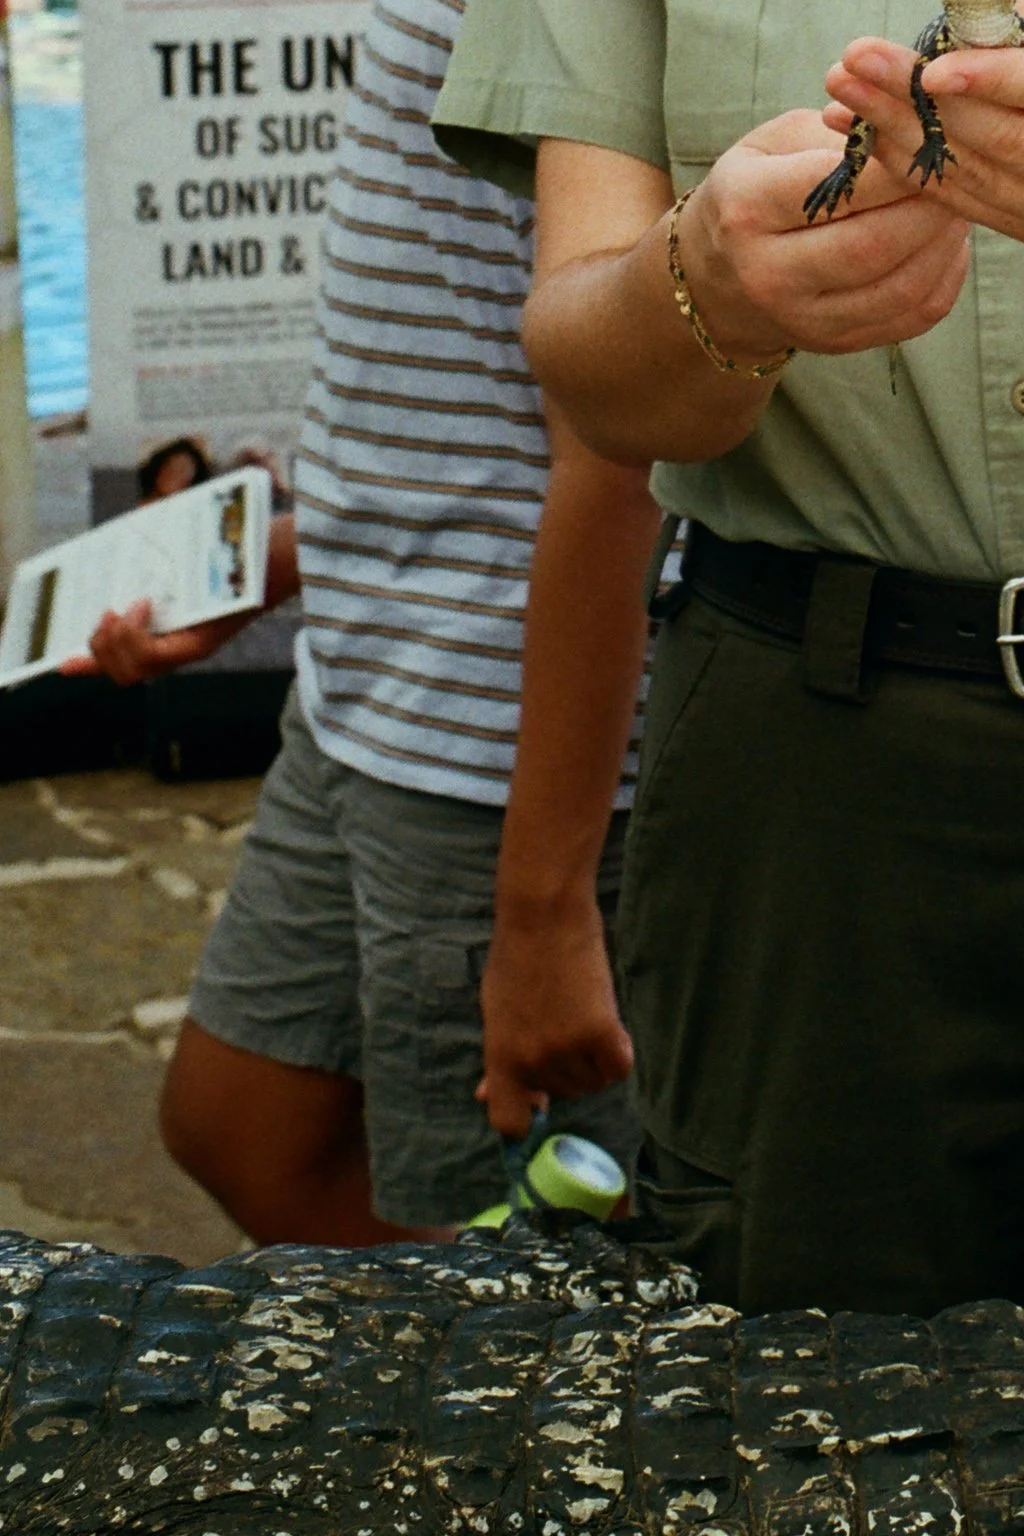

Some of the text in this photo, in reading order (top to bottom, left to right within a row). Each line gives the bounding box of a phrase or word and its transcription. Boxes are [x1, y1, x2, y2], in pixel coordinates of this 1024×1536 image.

[153, 32, 360, 100] THE UN
[196, 111, 338, 158] OF SUG
[135, 172, 328, 223] & CONVIC
[162, 234, 305, 283] LAND &
